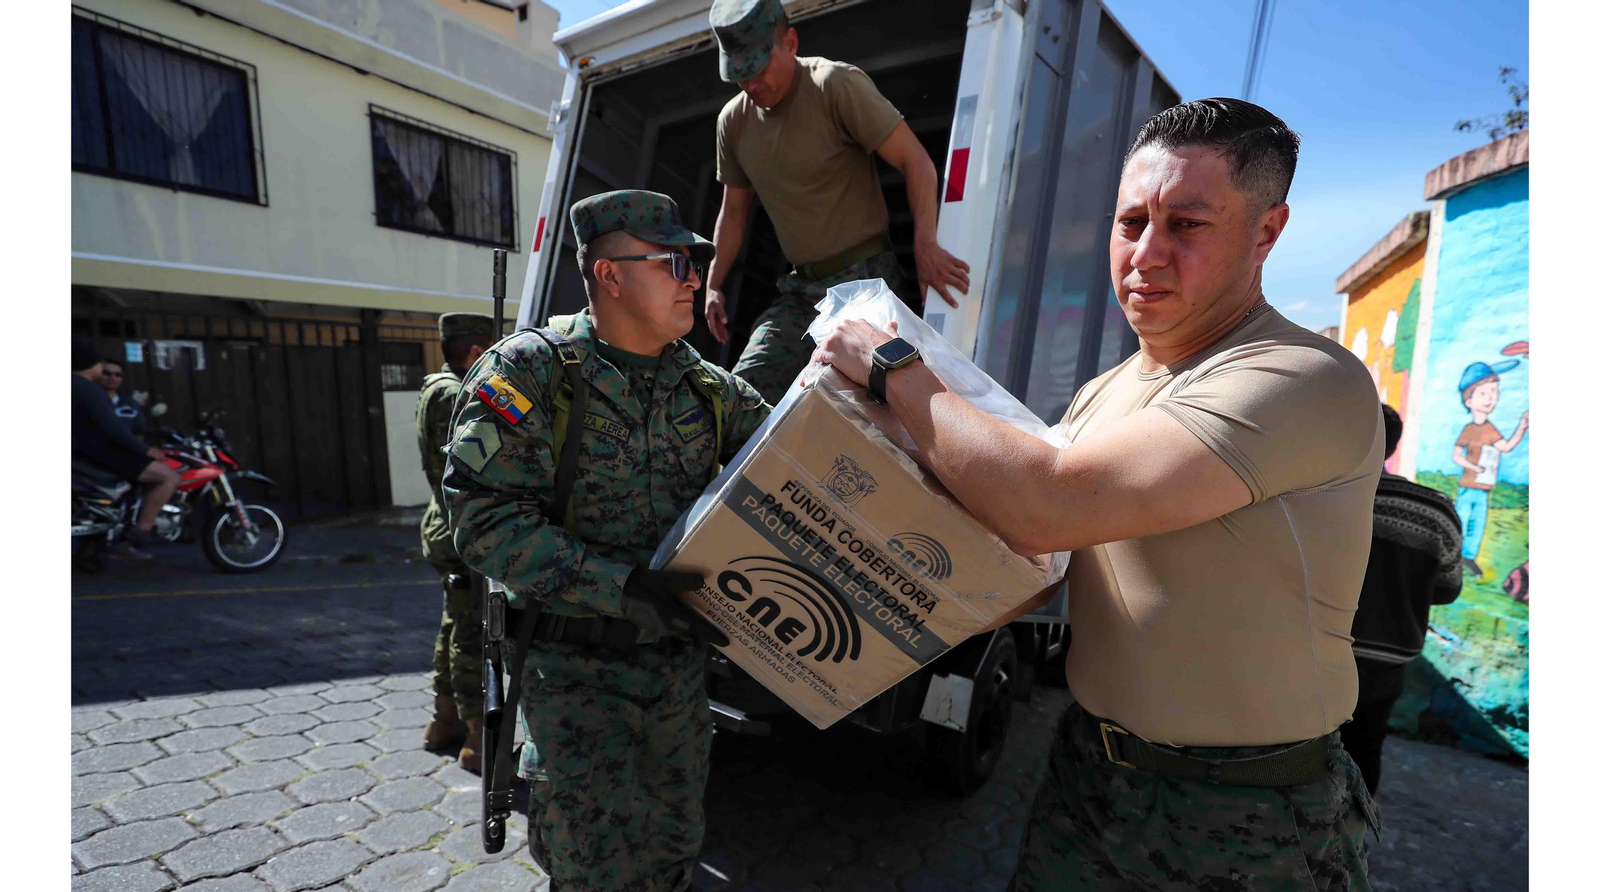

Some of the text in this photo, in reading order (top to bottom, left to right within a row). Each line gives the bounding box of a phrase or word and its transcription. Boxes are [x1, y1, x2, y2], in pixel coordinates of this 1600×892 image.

[583, 415, 627, 439] ZA AEREA
[780, 480, 937, 614] FUNDA COBERTORA
[821, 502, 832, 513] DEL
[832, 511, 857, 532] ECUADOR
[741, 495, 921, 648] PAQUETE ELECTORAL
[760, 493, 926, 633] PAQUETE ELECTORAL
[865, 540, 941, 602] CONSEJO NACIONAL ELECTORAL
[701, 583, 838, 695] ONSEJO NACIONAL ELECTORAL
[705, 609, 796, 684] FUERZAS ARMADAS
[740, 625, 785, 660] MATERIAL
[786, 661, 838, 706] ELECTORAL
